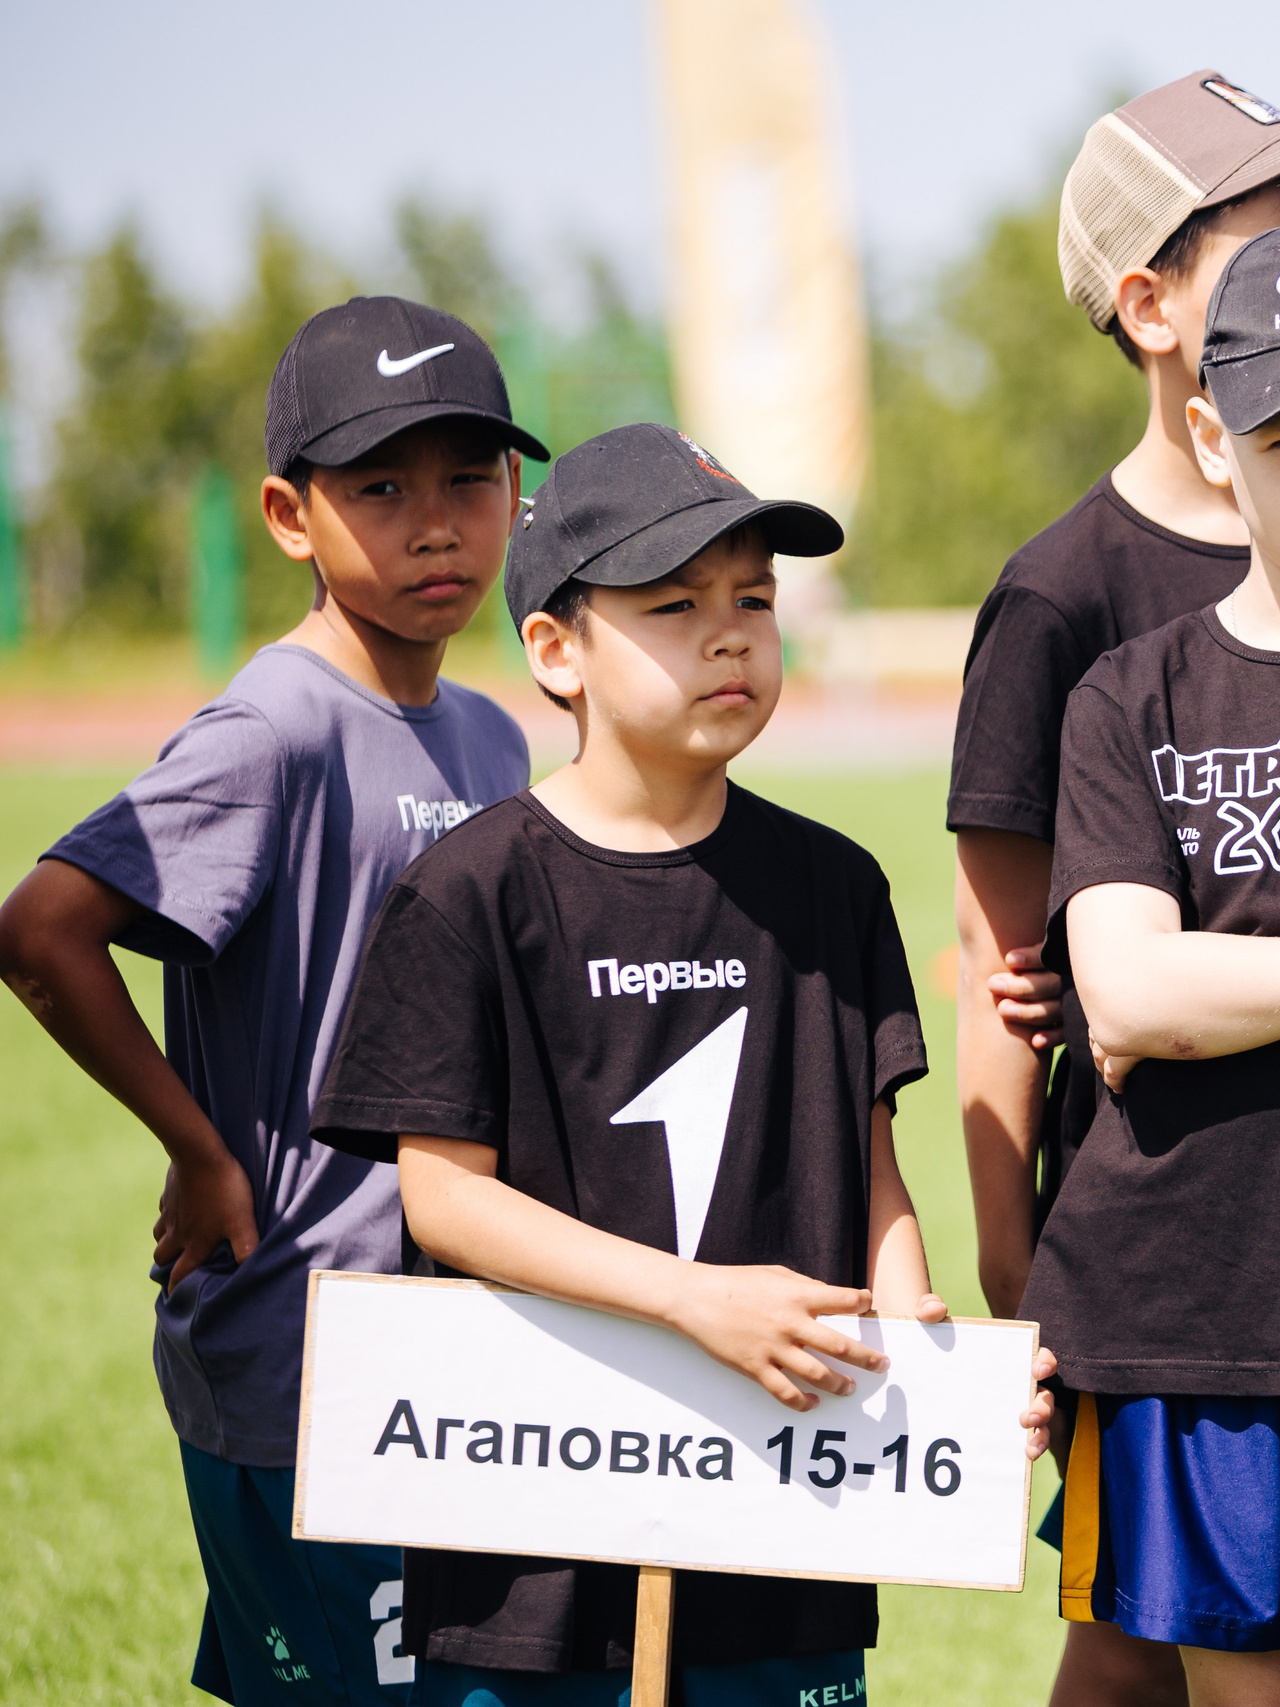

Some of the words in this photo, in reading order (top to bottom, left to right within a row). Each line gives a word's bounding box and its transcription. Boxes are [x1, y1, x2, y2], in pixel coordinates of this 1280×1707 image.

[587, 958, 747, 1004] Первые
[373, 1398, 735, 1482] Агаповка
[766, 1425, 963, 1497] 15-16
